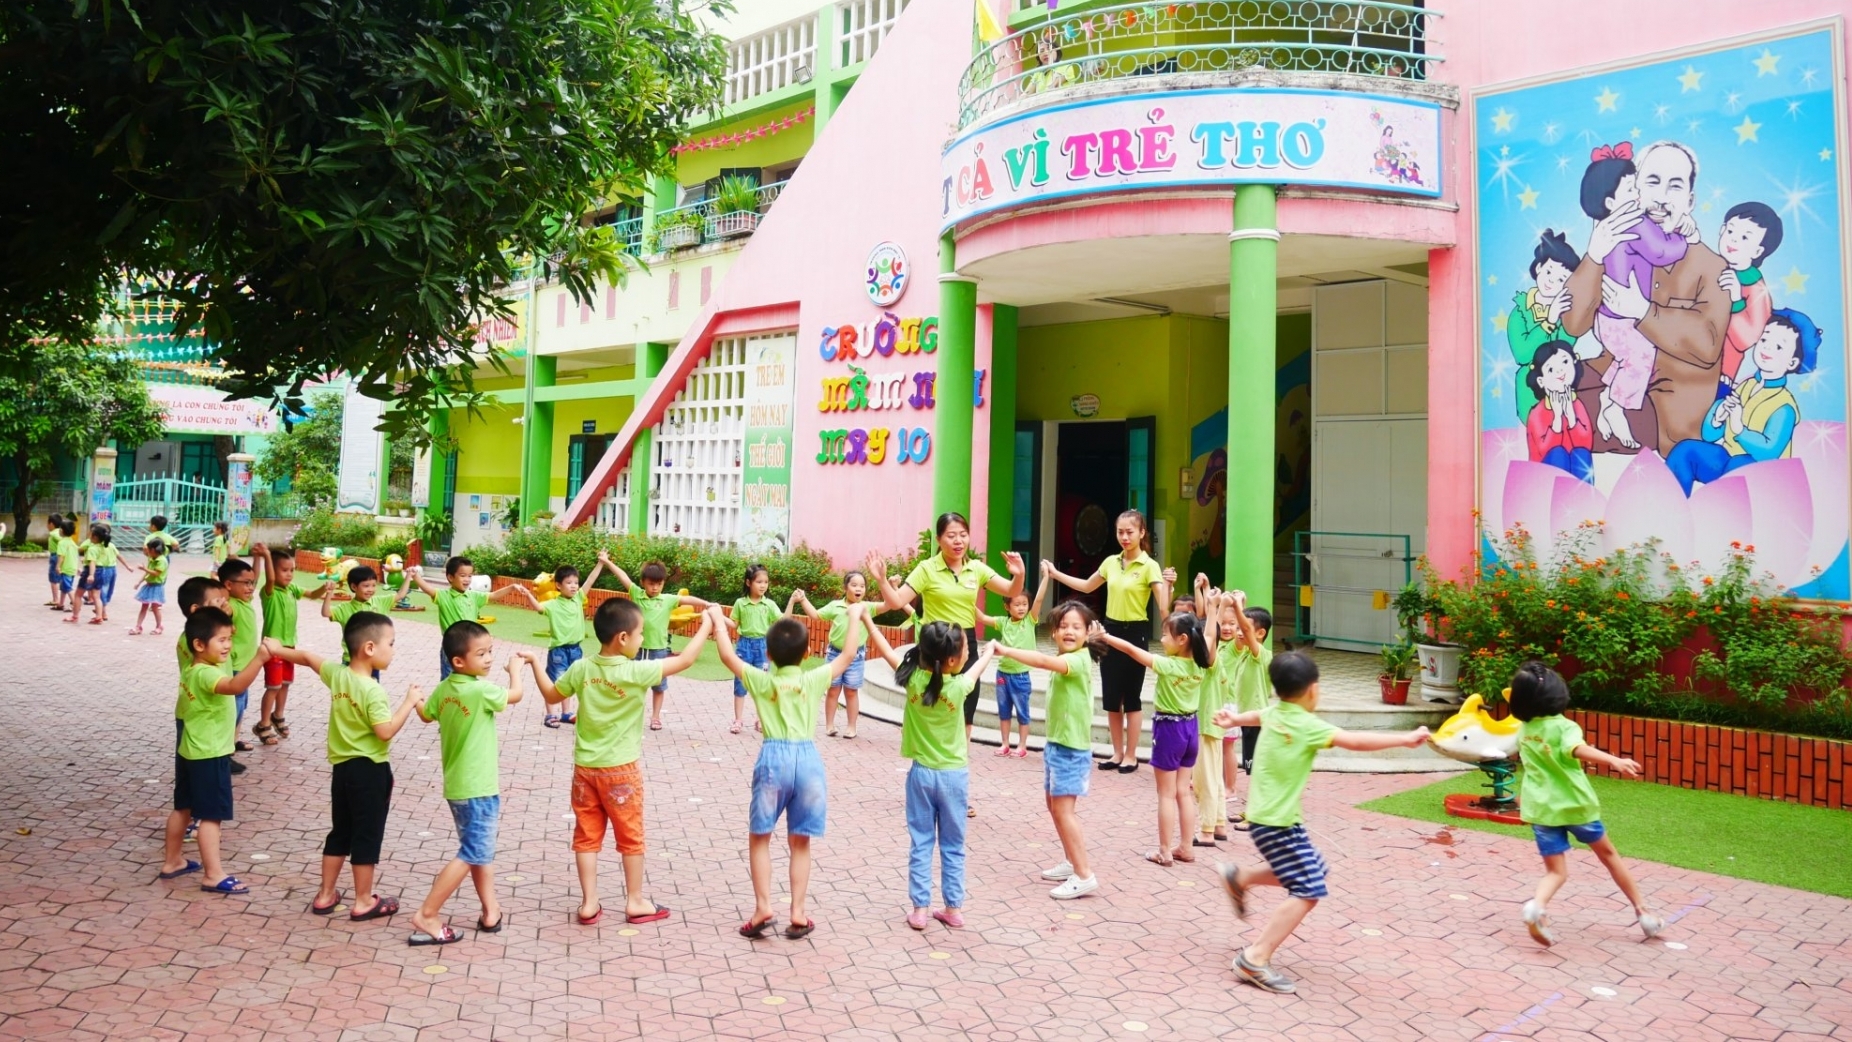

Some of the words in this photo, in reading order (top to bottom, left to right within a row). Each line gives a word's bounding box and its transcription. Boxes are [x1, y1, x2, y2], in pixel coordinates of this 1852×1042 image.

[957, 142, 994, 205] CẢ
[1003, 128, 1050, 190] VÌ
[1063, 107, 1177, 178] TRẺ
[1193, 118, 1327, 169] THƠ
[819, 312, 939, 361] TRƯỜNG
[772, 363, 786, 386] EM
[818, 363, 906, 412] MẦM
[769, 403, 788, 427] NAY
[816, 428, 890, 465] MAY
[897, 426, 931, 465] 10
[769, 484, 788, 508] MAI
